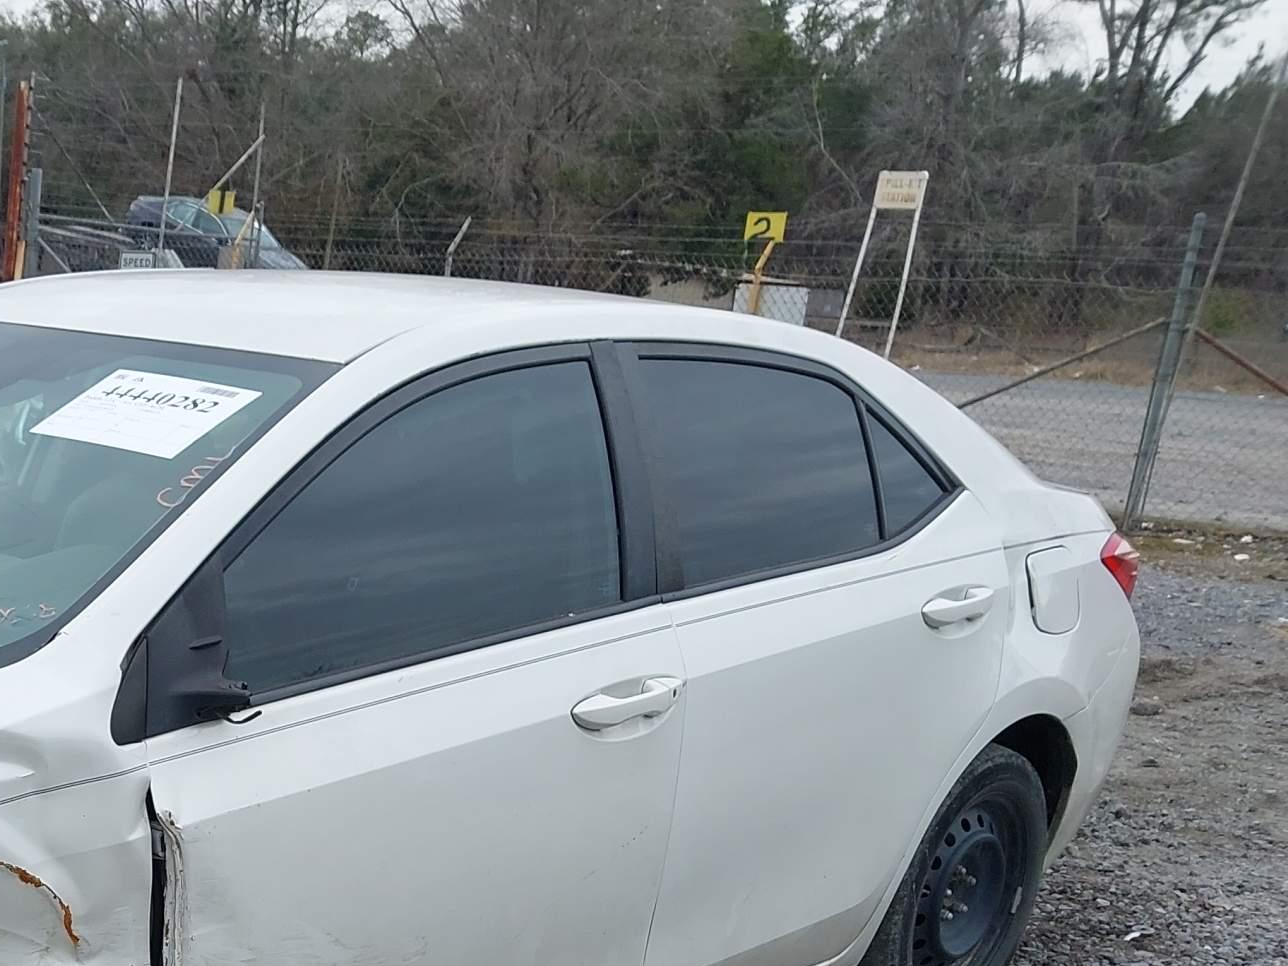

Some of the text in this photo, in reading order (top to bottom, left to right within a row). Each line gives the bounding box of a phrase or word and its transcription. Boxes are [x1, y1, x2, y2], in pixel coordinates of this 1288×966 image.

[748, 217, 776, 241] 2
[123, 257, 151, 268] SPEED
[101, 385, 220, 413] 44440282
